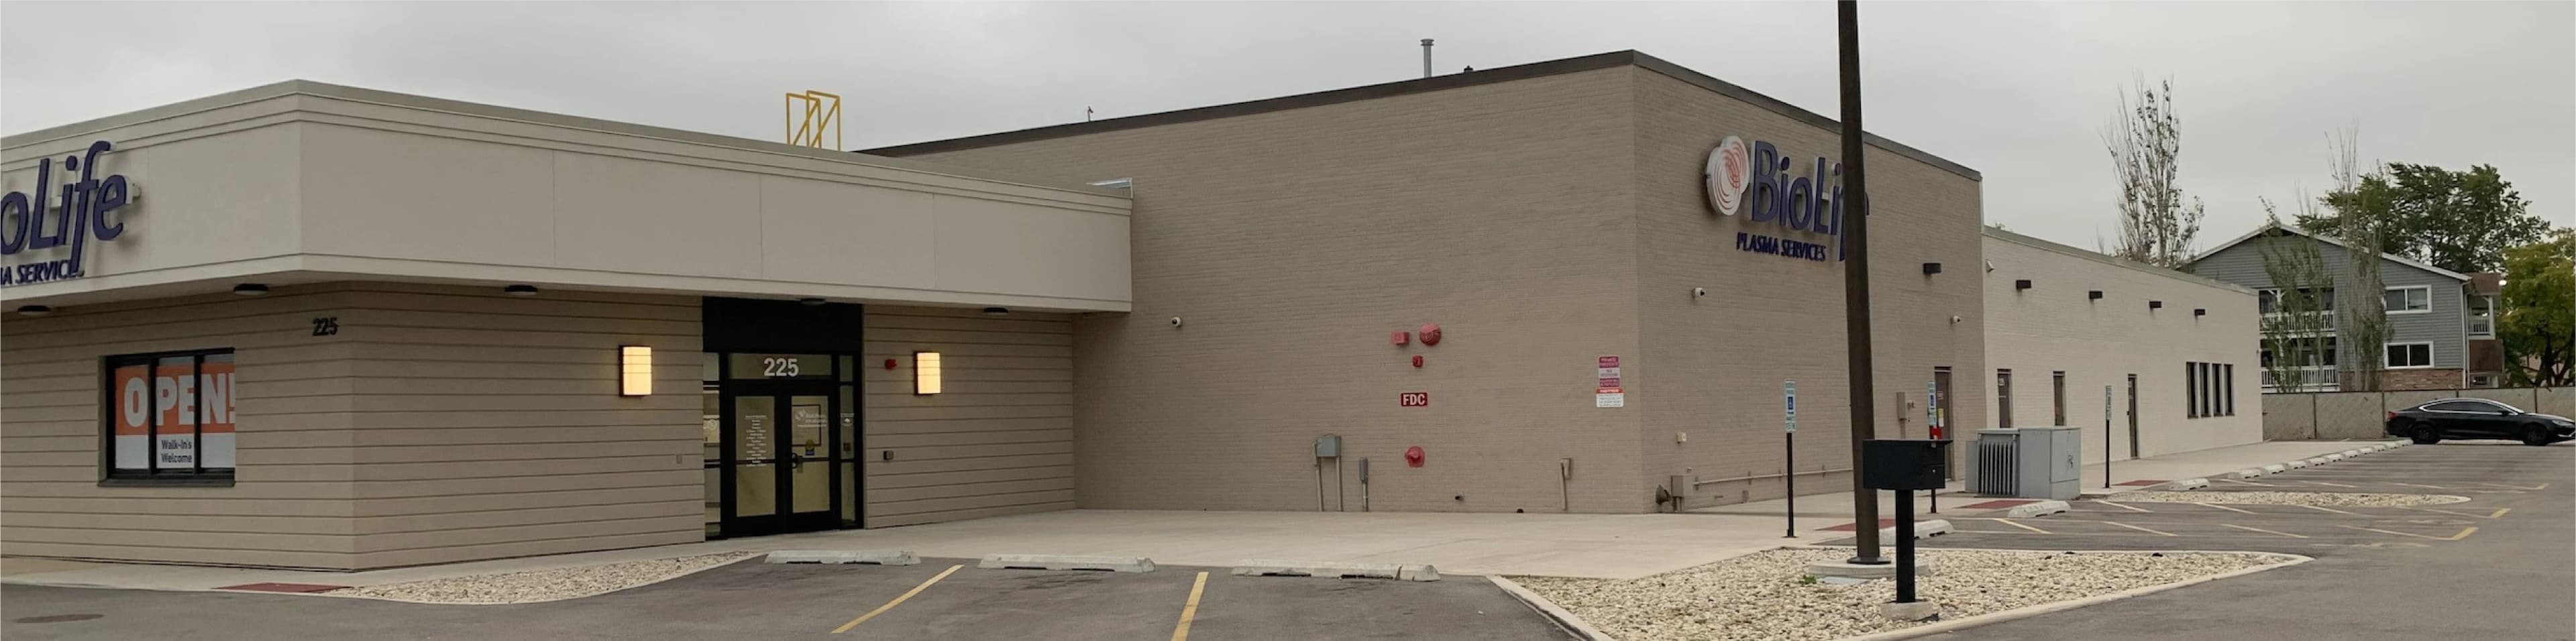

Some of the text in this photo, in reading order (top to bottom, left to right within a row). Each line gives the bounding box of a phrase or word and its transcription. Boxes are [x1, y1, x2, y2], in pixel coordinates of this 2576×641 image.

[1752, 140, 1870, 261] BioLi
[1736, 232, 1826, 262] PLASMA SERVICES
[15, 259, 85, 284] SERVIC
[313, 318, 338, 336] 225
[763, 358, 799, 376] 225
[124, 373, 235, 427] OPEN!
[1403, 394, 1425, 405] FDC
[161, 453, 193, 463] Welcome
